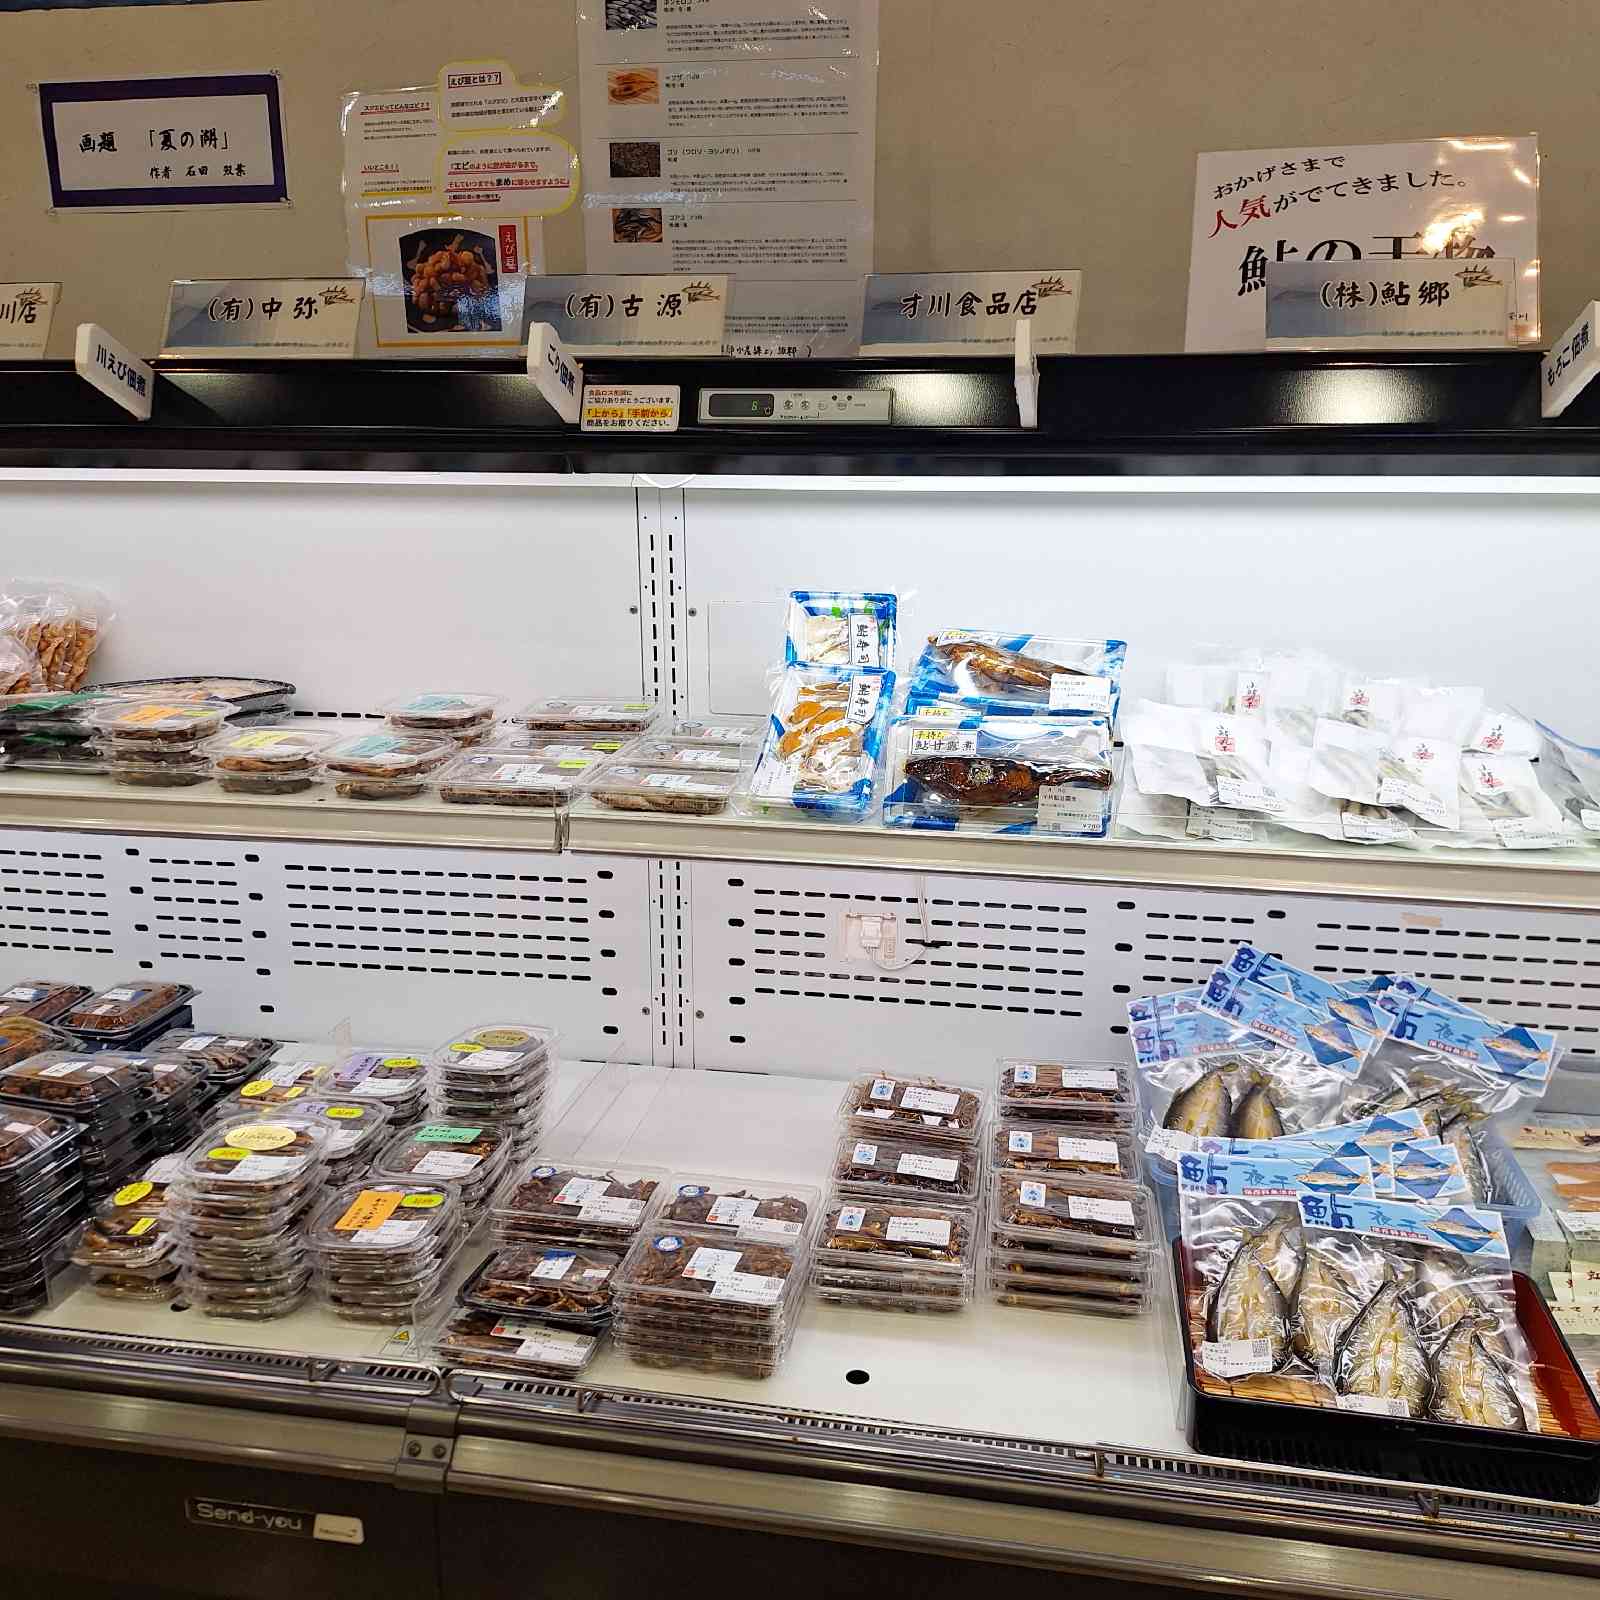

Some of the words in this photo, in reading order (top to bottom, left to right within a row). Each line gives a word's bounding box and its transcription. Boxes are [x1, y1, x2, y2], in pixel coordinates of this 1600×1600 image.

[79, 131, 118, 152] 画題
[149, 128, 229, 151] 「夏の湖」
[149, 167, 172, 179] 作者
[1213, 156, 1346, 200] おかげさまで
[1207, 170, 1468, 239] 人気がでてきました。
[1300, 1193, 1354, 1229] 鮎
[196, 1502, 303, 1530] Send-you
